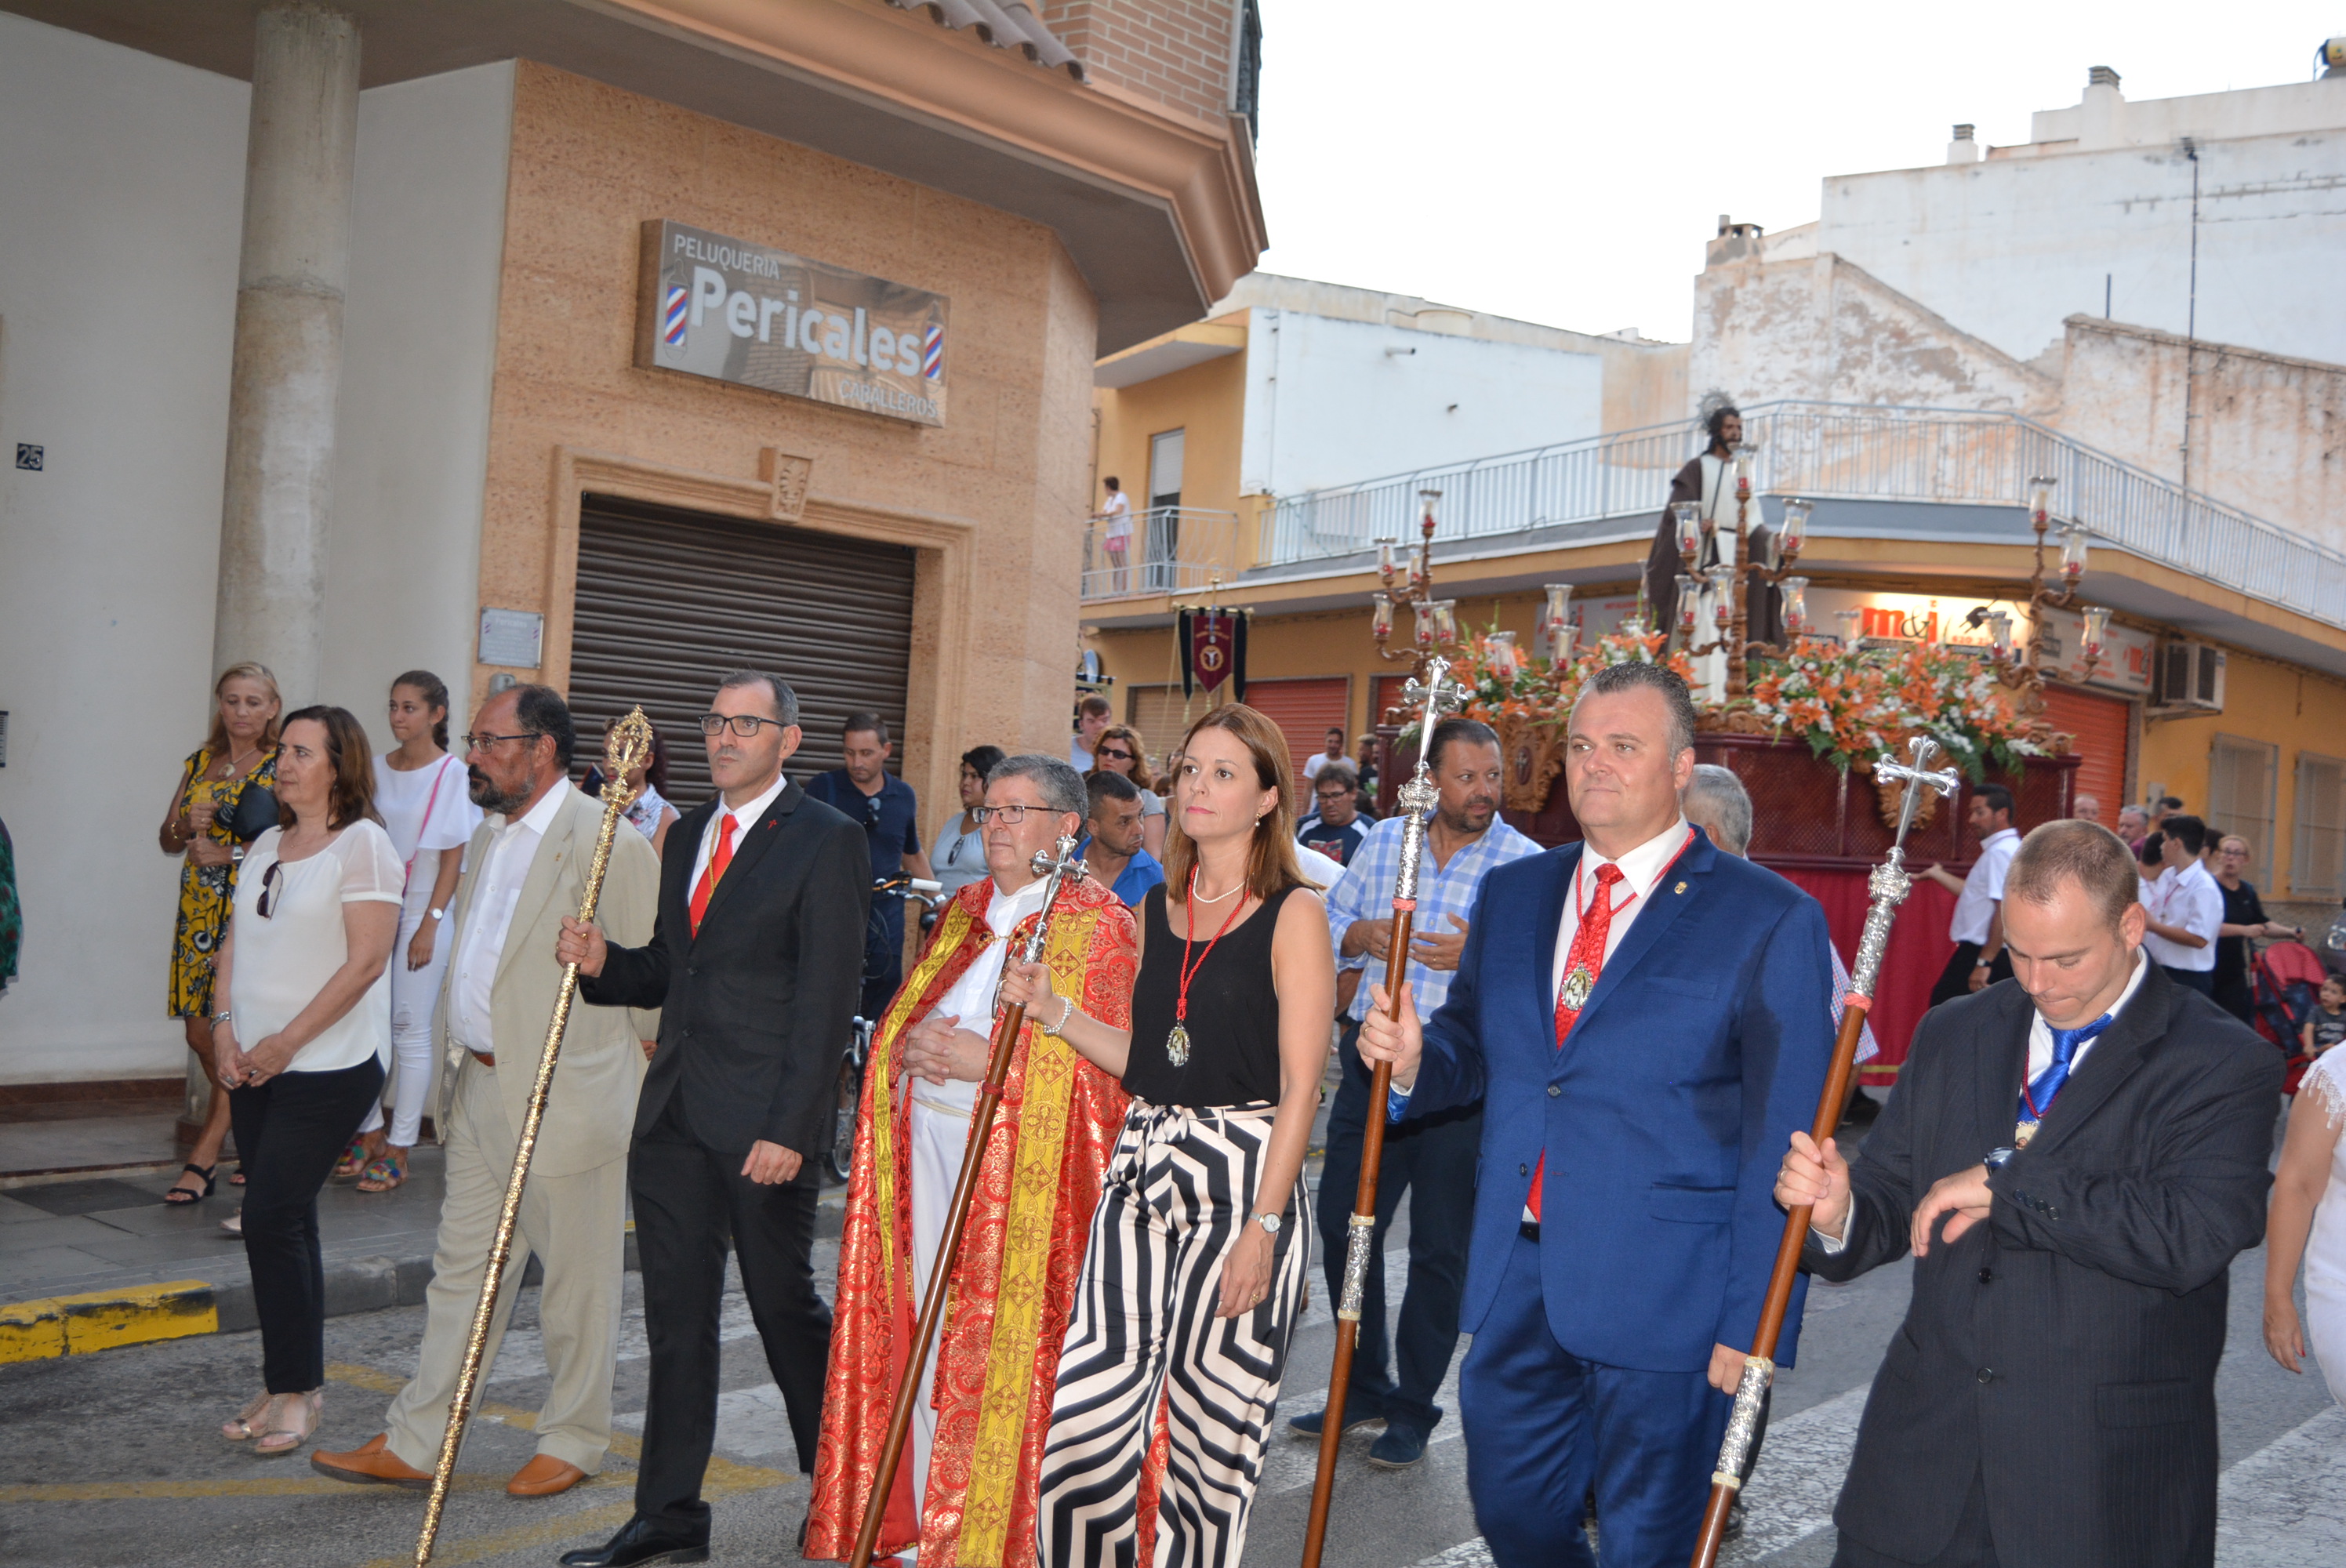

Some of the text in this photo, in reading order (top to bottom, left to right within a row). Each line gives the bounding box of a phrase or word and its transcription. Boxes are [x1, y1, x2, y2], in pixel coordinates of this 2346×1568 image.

[674, 234, 780, 281] PELUQUERIA
[691, 266, 922, 377] Pericales
[840, 379, 938, 419] CABALLEROS
[17, 445, 42, 469] 25
